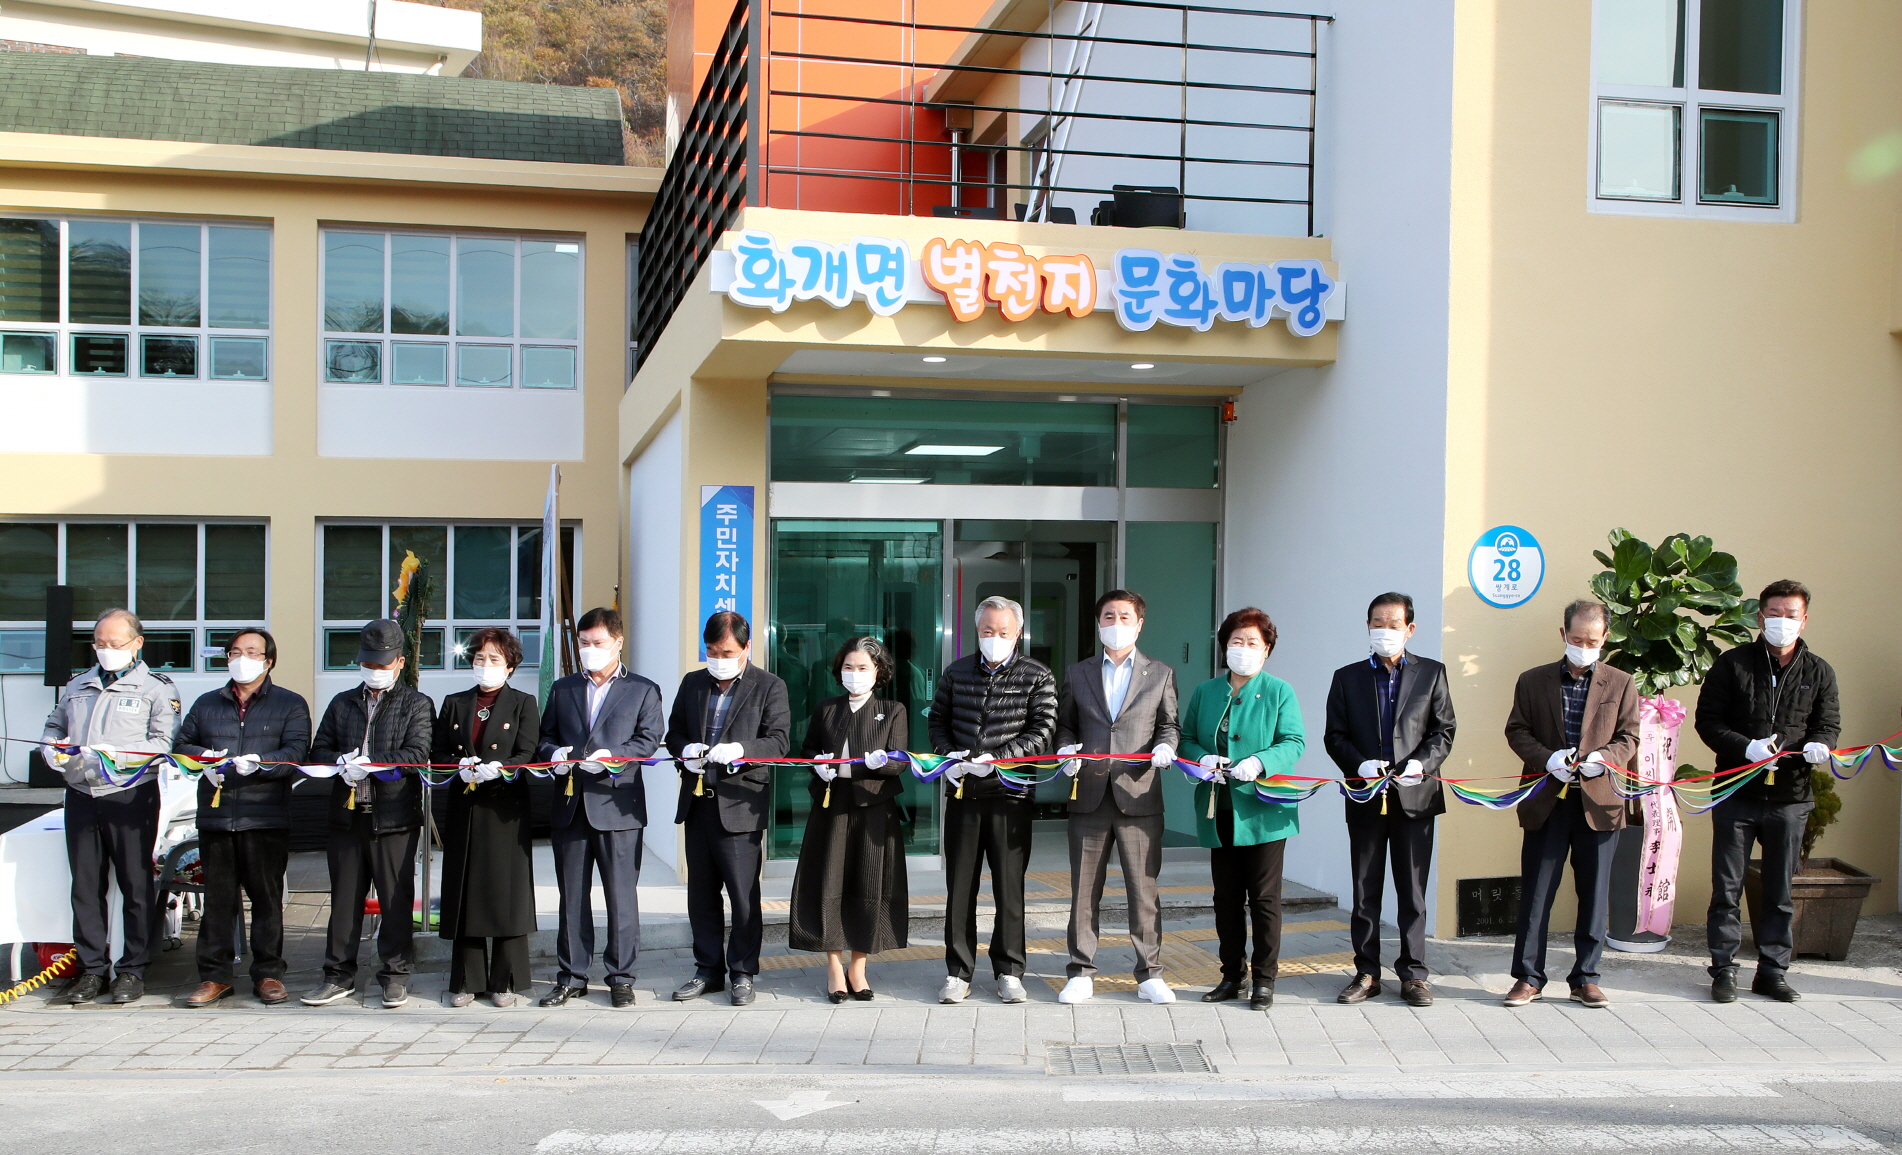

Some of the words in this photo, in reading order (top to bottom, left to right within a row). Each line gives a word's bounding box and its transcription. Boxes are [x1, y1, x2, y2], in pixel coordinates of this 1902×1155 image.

[736, 235, 906, 308] 화개면
[929, 242, 1093, 311] 별천지
[1118, 247, 1329, 327] 문화마당
[1492, 558, 1521, 582] 28
